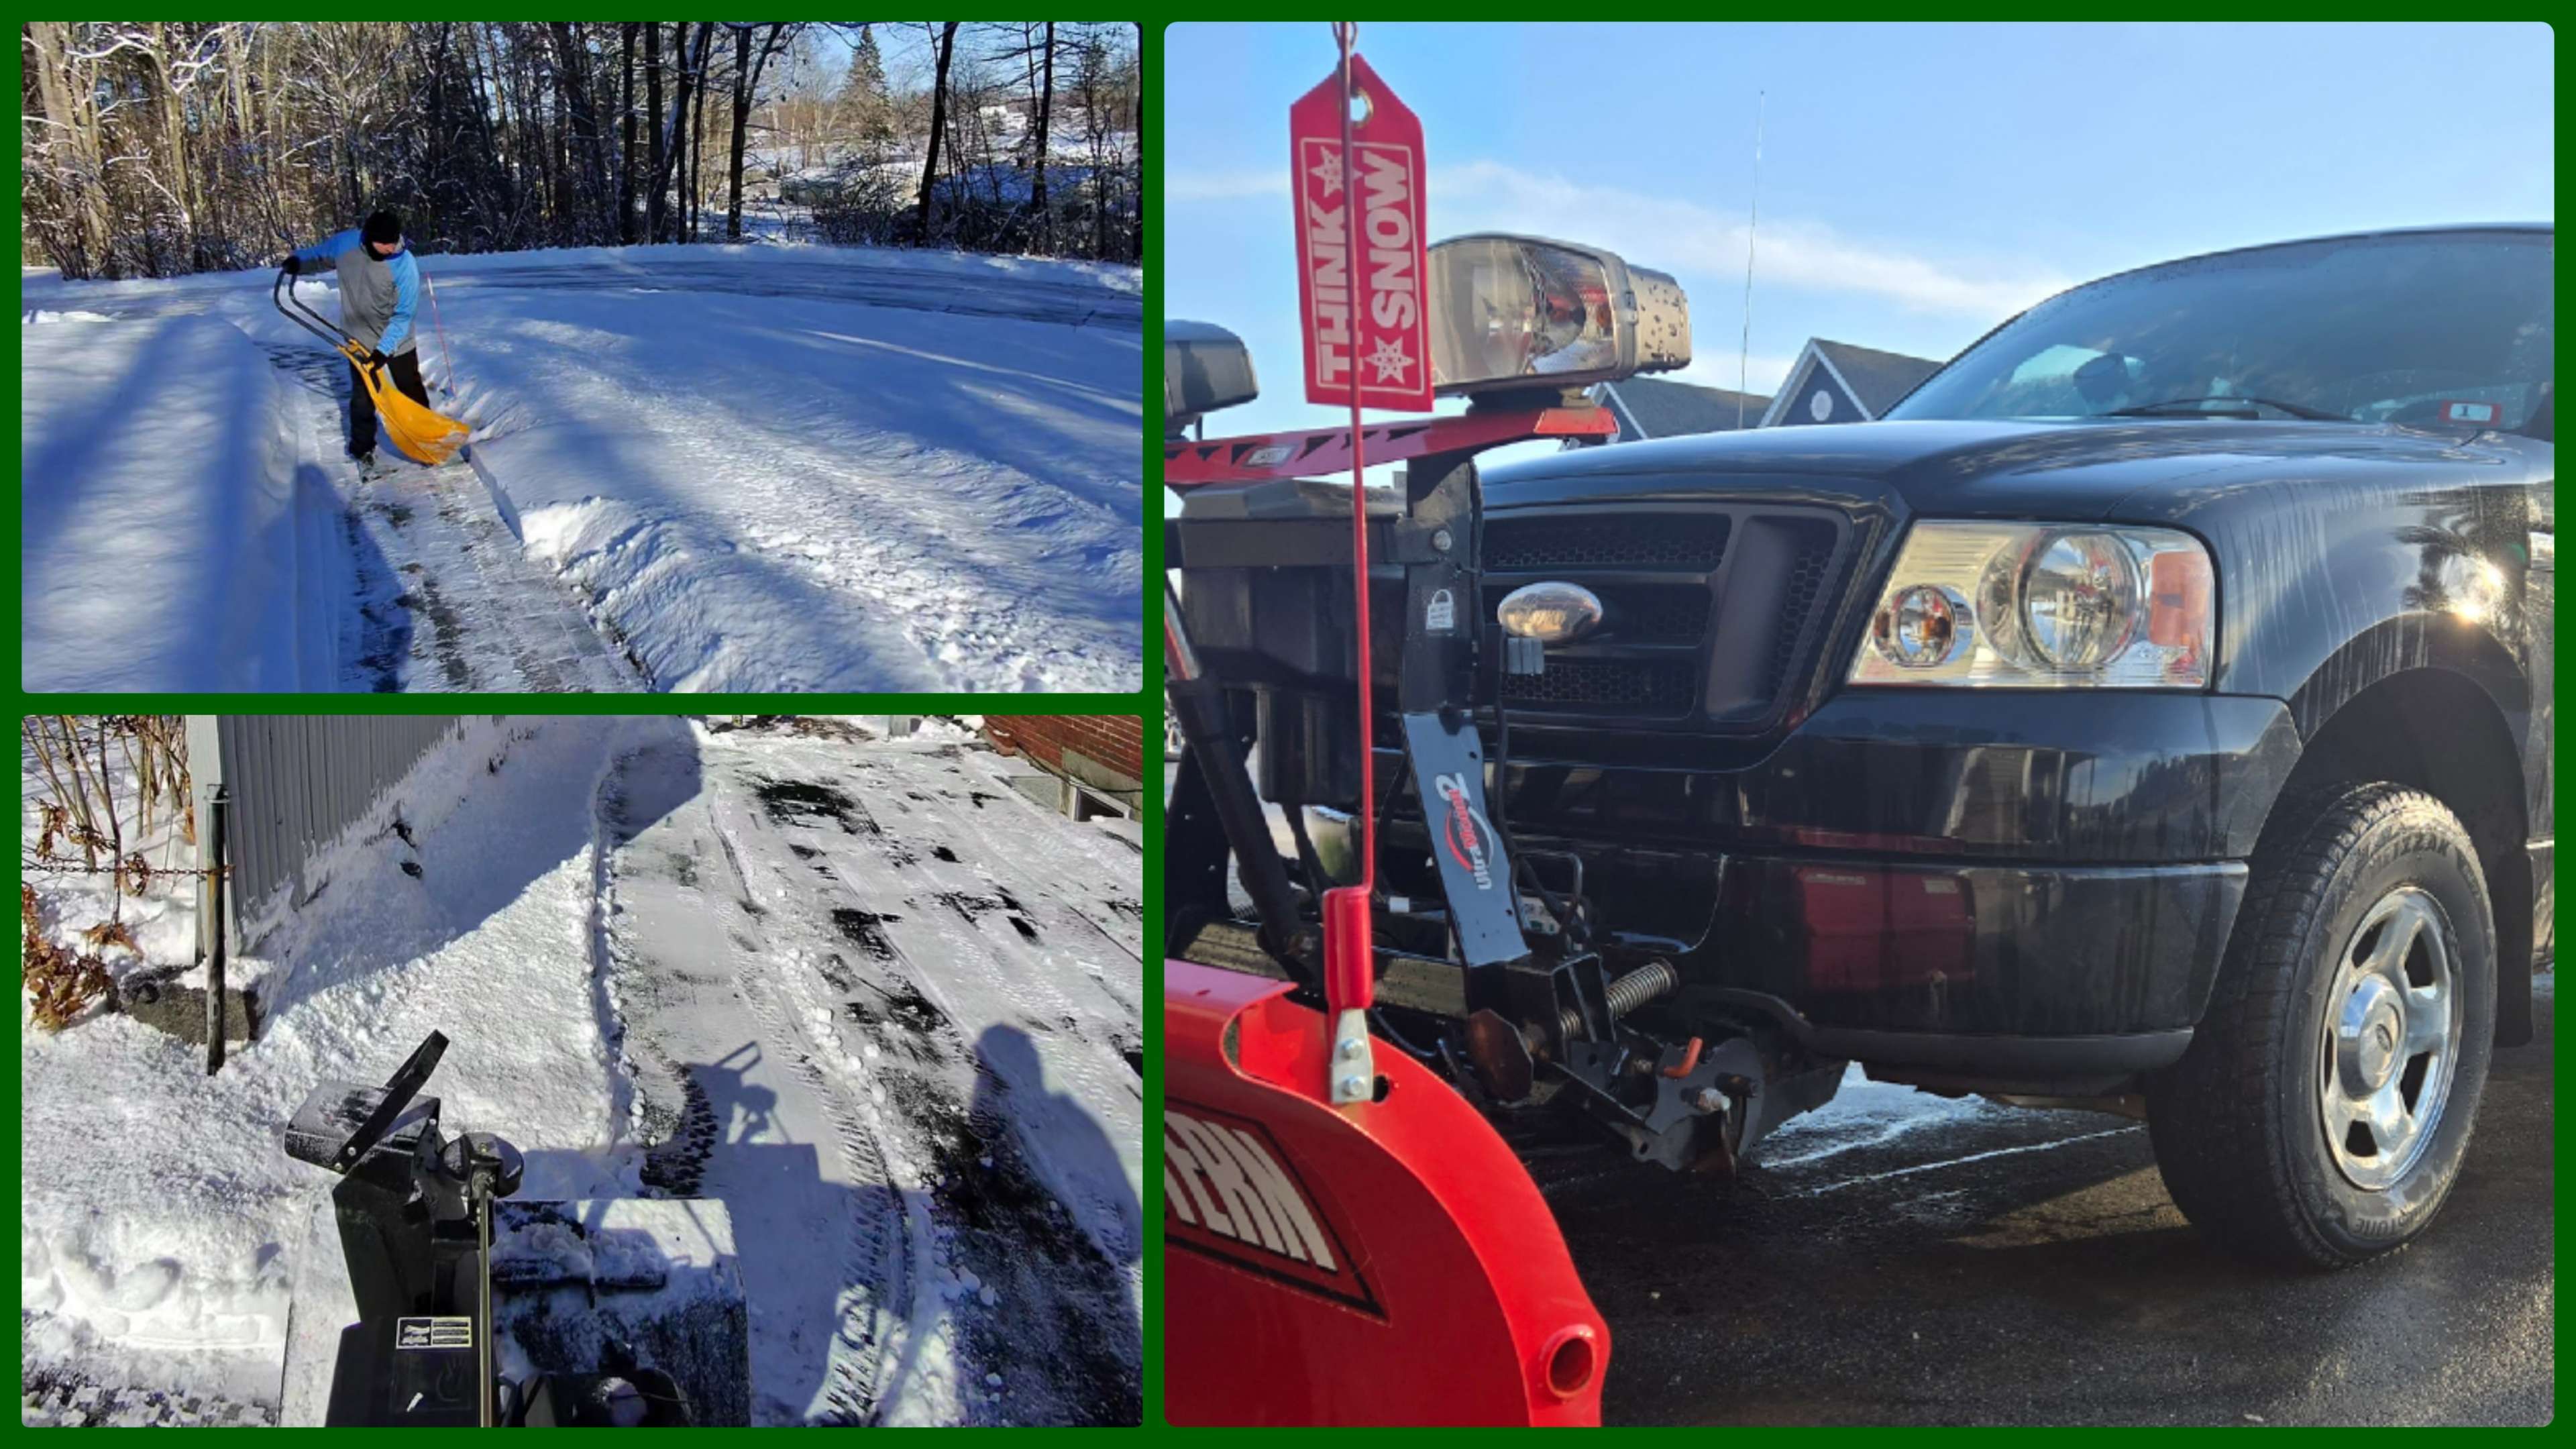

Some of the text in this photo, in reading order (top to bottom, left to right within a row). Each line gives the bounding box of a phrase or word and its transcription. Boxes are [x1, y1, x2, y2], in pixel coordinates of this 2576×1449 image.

[1309, 197, 1363, 382] THINK
[1362, 150, 1416, 329] SNOW
[1436, 772, 1470, 802] 2
